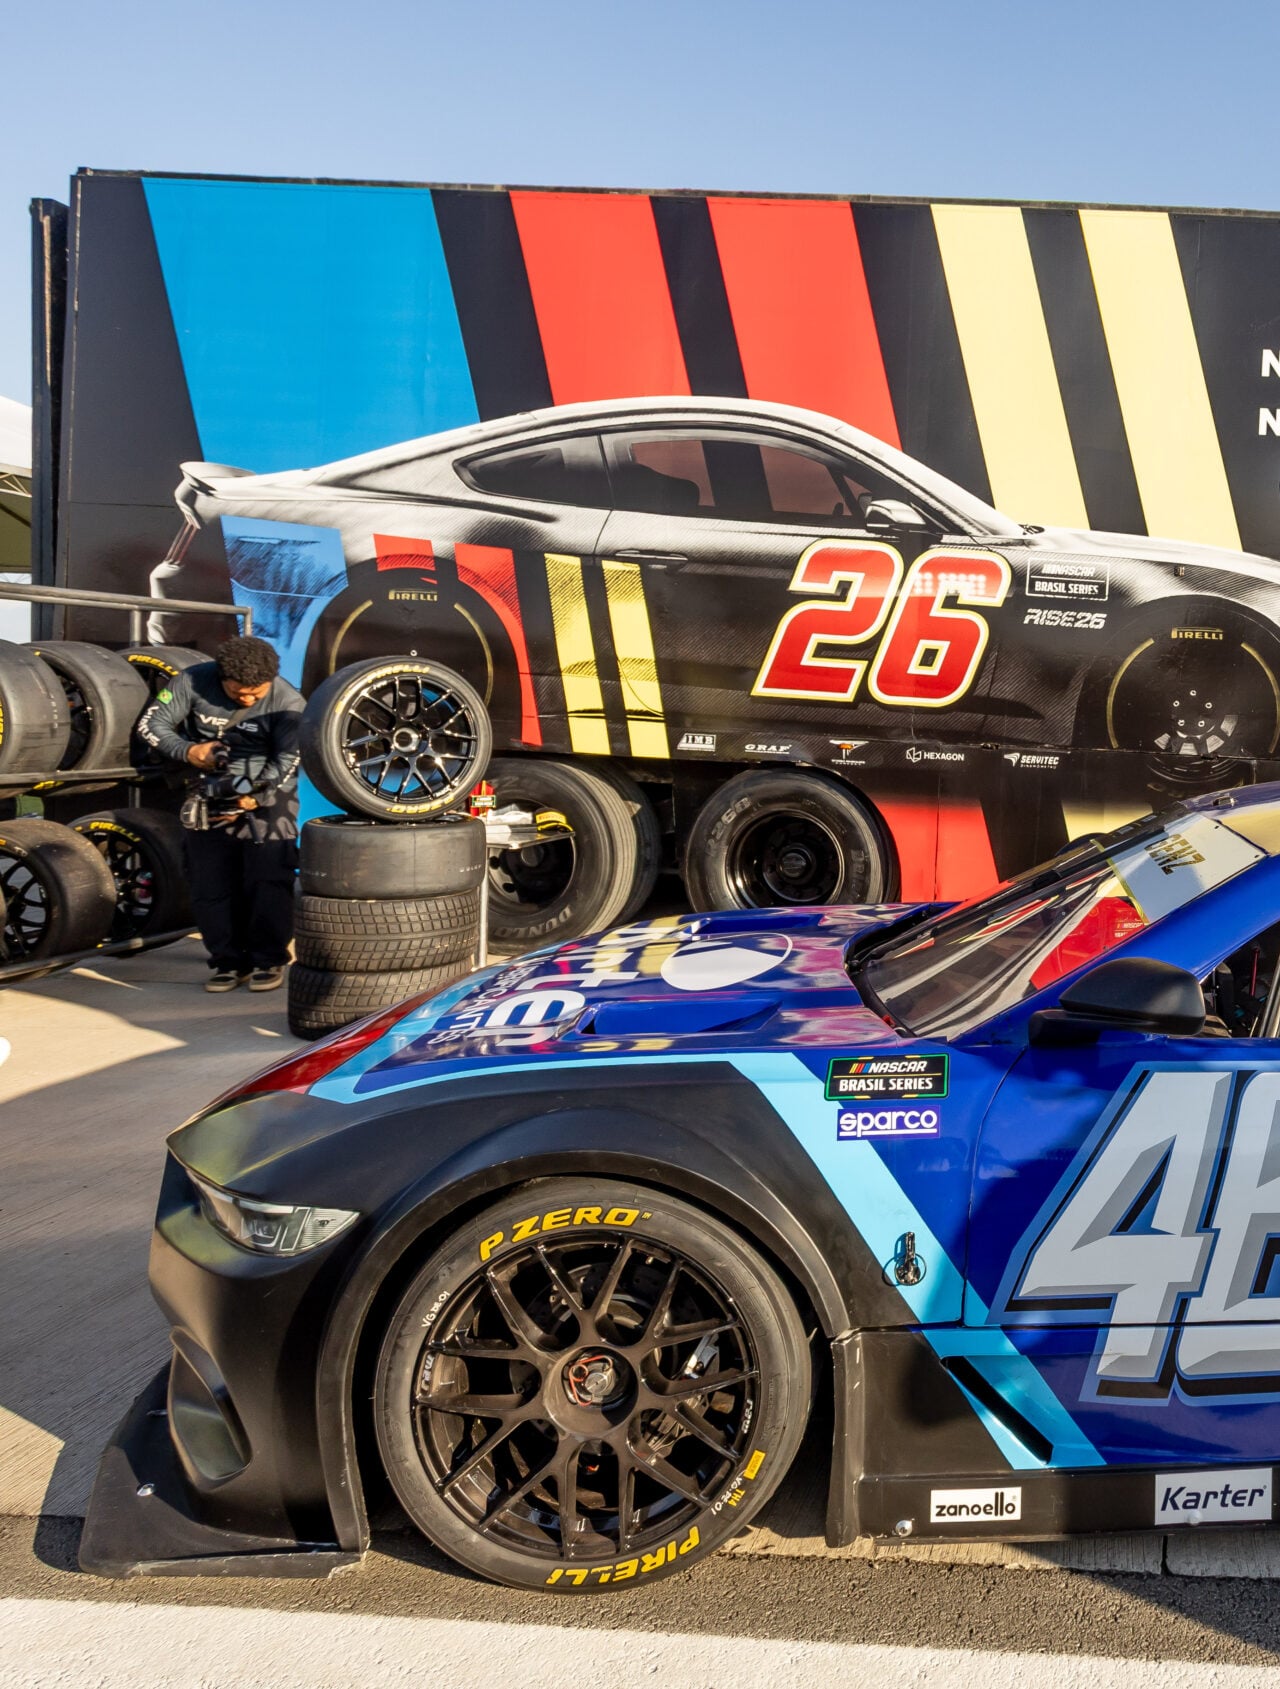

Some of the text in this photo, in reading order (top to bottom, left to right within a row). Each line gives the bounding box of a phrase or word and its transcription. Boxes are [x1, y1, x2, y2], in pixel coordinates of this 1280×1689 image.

[388, 588, 438, 602] PIRELLI
[1034, 581, 1099, 596] BRASIL SERIES
[751, 538, 1013, 707] 26
[1023, 608, 1107, 630] RISE26
[1171, 627, 1223, 641] PIRELLI
[199, 714, 259, 732] VIRUS
[744, 743, 790, 753] GRAF
[923, 751, 965, 761] HEXAGON
[1020, 755, 1059, 765] SERVITEC
[868, 1060, 928, 1074] NASCAR
[839, 1076, 933, 1092] BRASIL SERIES
[839, 1110, 938, 1138] sparco
[479, 1231, 504, 1262] P
[511, 1206, 640, 1243] ZERO
[935, 1488, 1016, 1517] zanoello
[1161, 1484, 1264, 1511] Karter
[546, 1525, 701, 1585] PIRELLI
